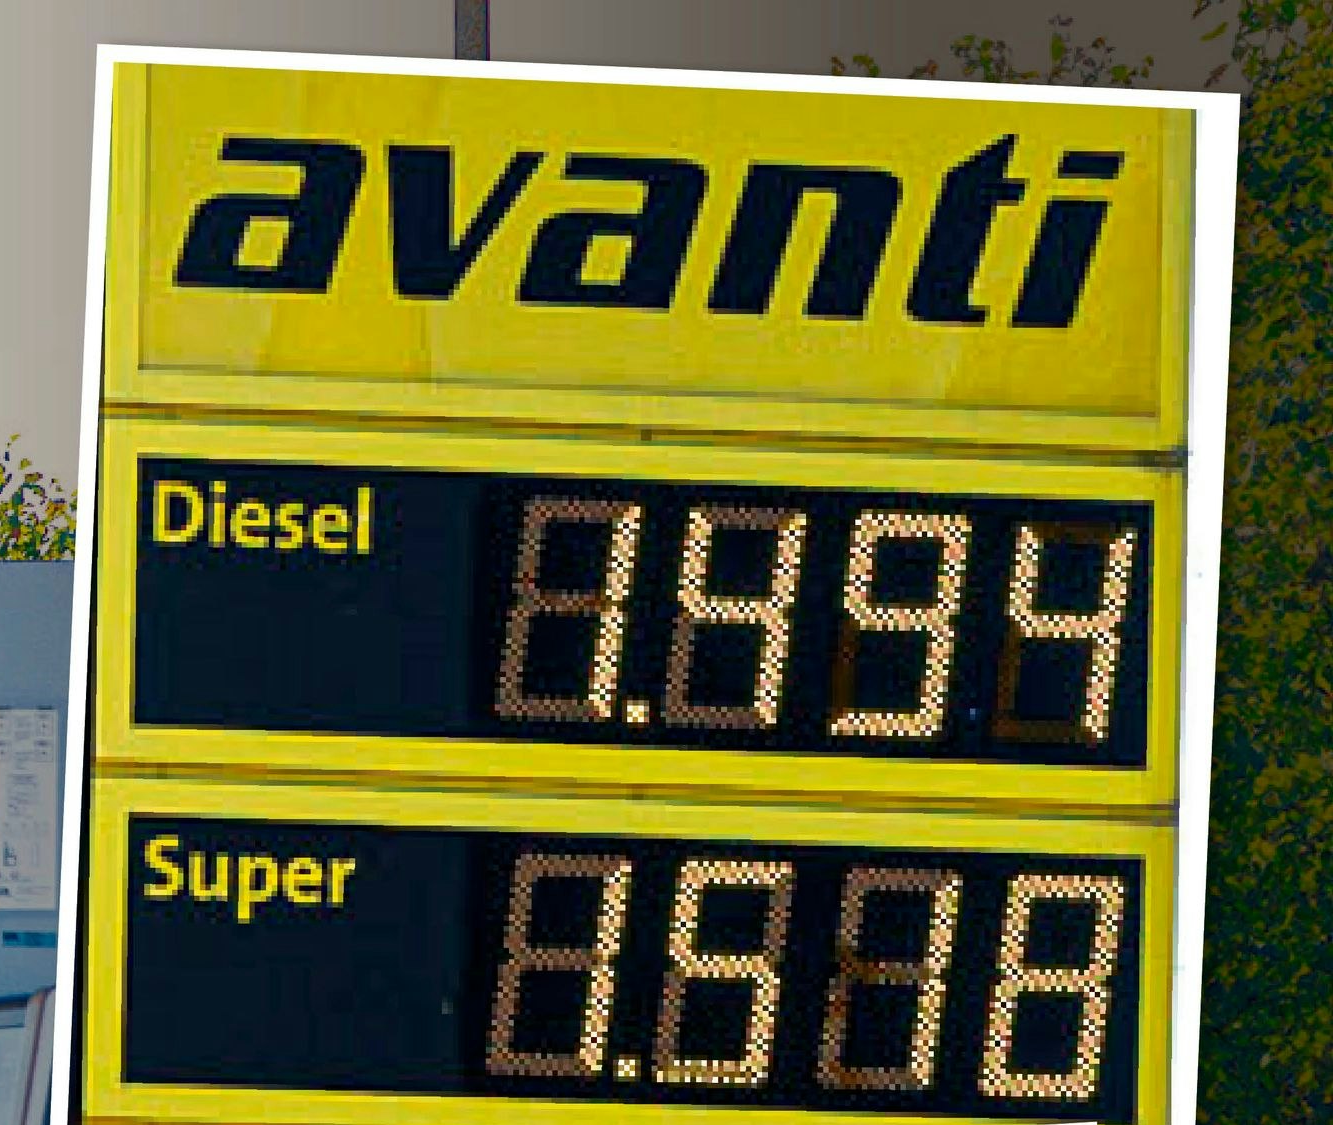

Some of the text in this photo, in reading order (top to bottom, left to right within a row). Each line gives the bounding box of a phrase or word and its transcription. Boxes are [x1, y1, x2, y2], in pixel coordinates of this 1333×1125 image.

[174, 130, 1126, 329] avanti
[150, 479, 375, 555] Diesel
[589, 501, 1138, 741] 1.494
[143, 834, 357, 925] Super
[576, 858, 1125, 1099] 1.518
